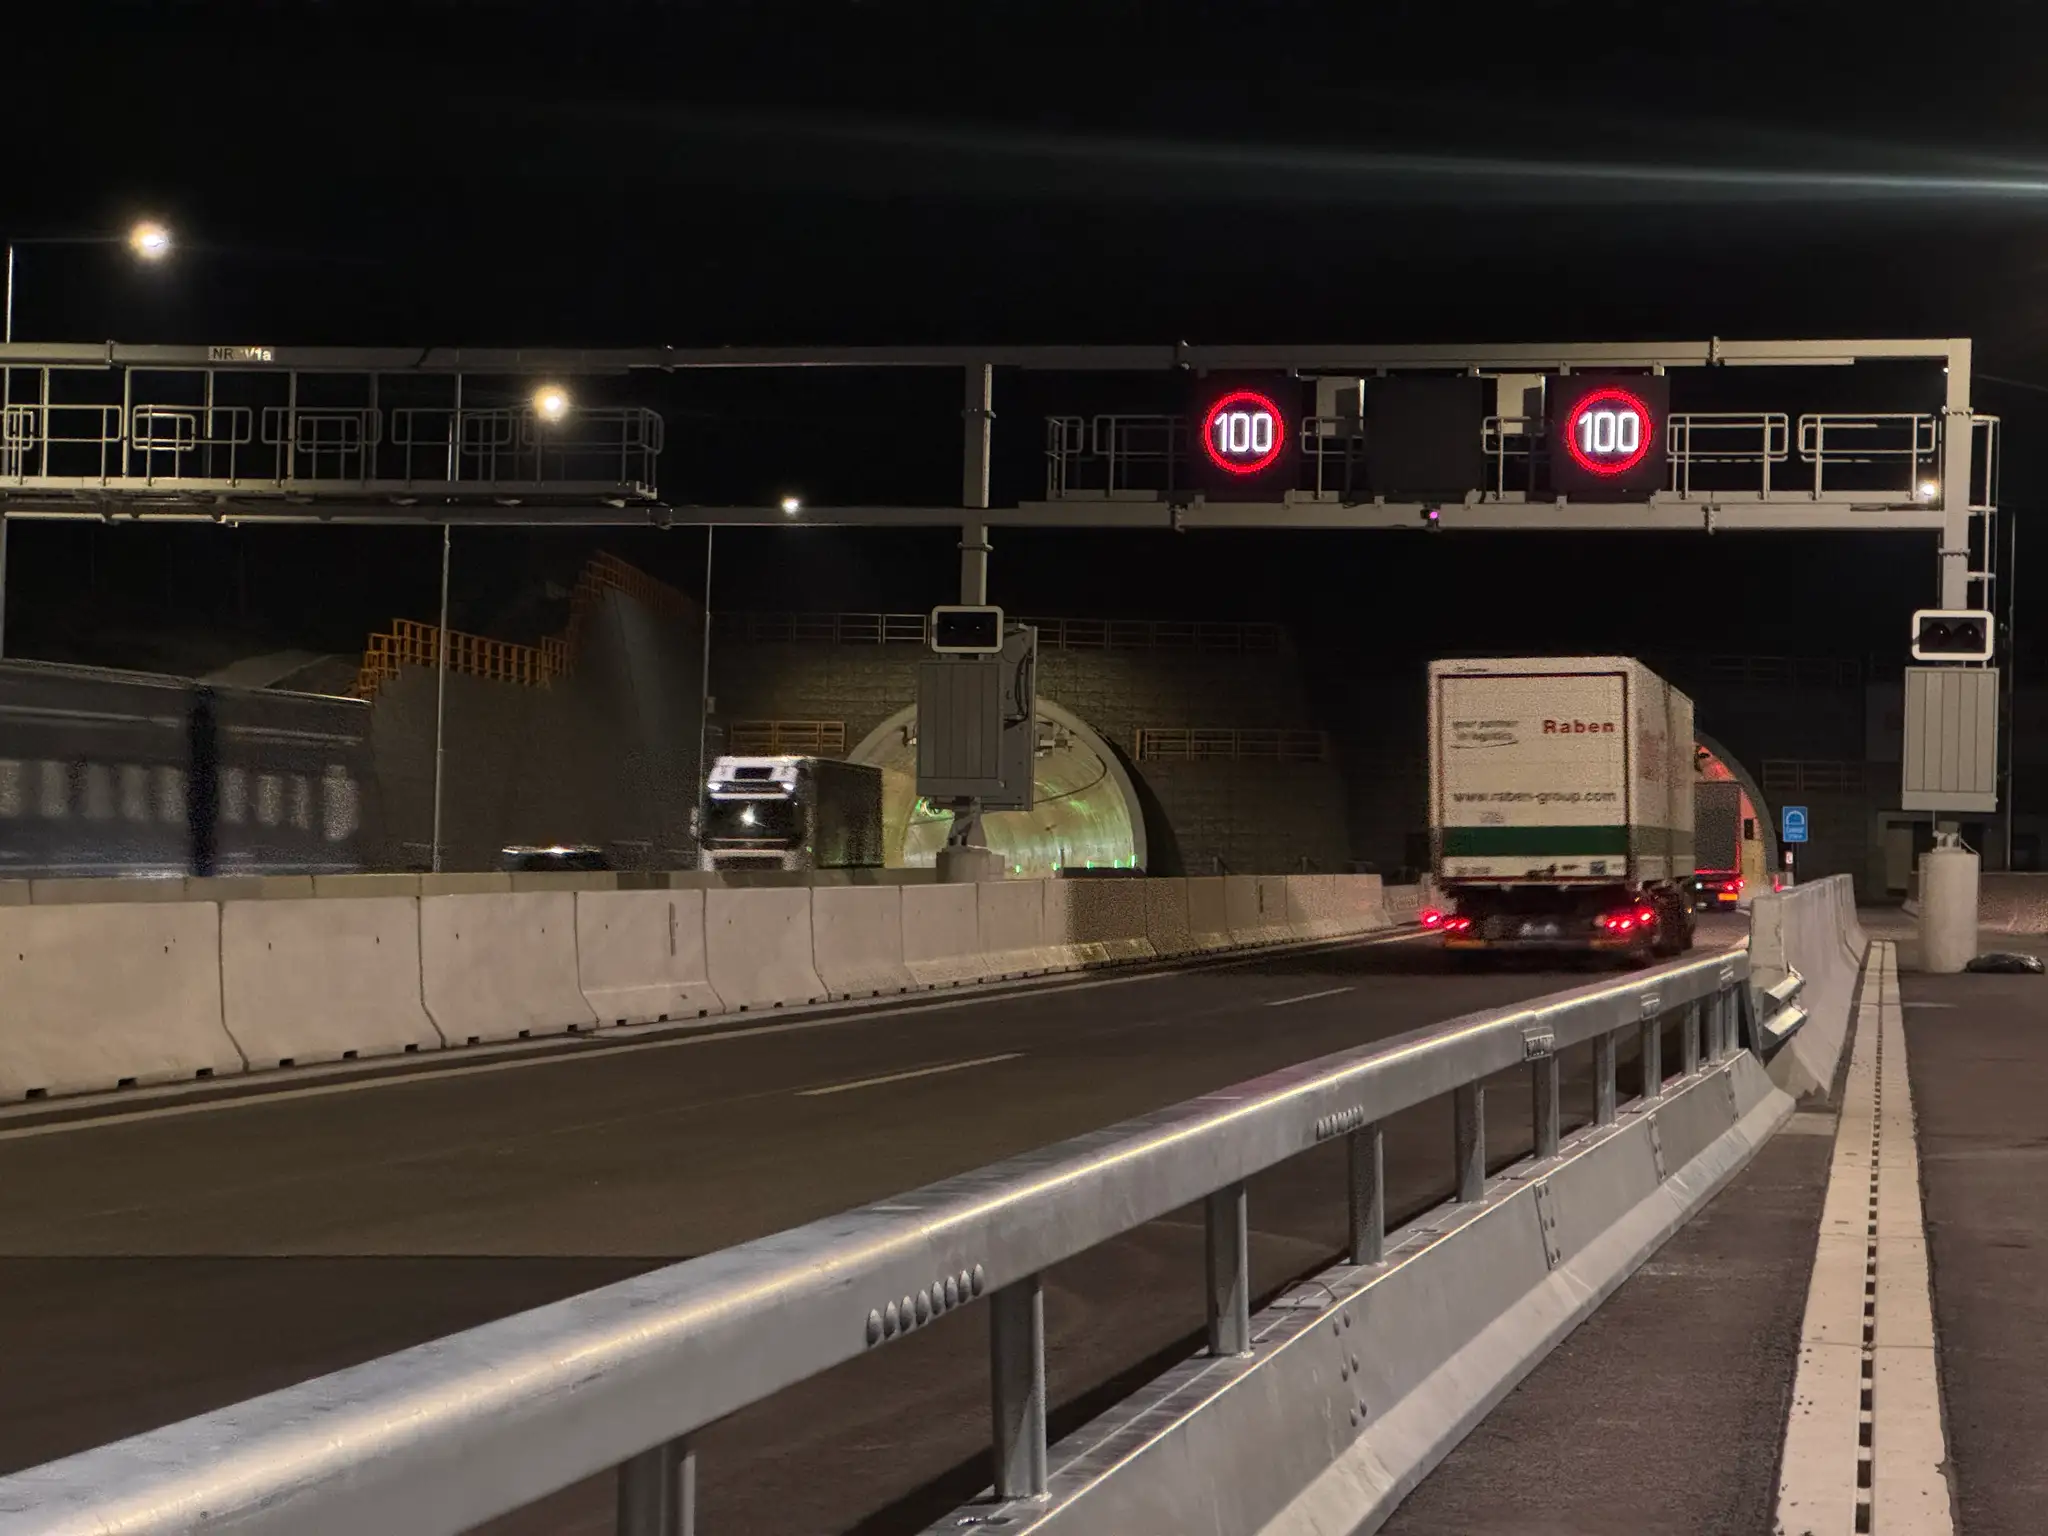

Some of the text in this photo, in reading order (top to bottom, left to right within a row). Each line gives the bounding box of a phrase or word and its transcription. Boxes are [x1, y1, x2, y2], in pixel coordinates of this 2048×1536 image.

[213, 347, 234, 360] NR
[1214, 412, 1273, 453] 100
[1577, 411, 1640, 453] 100
[1543, 719, 1615, 734] Raben
